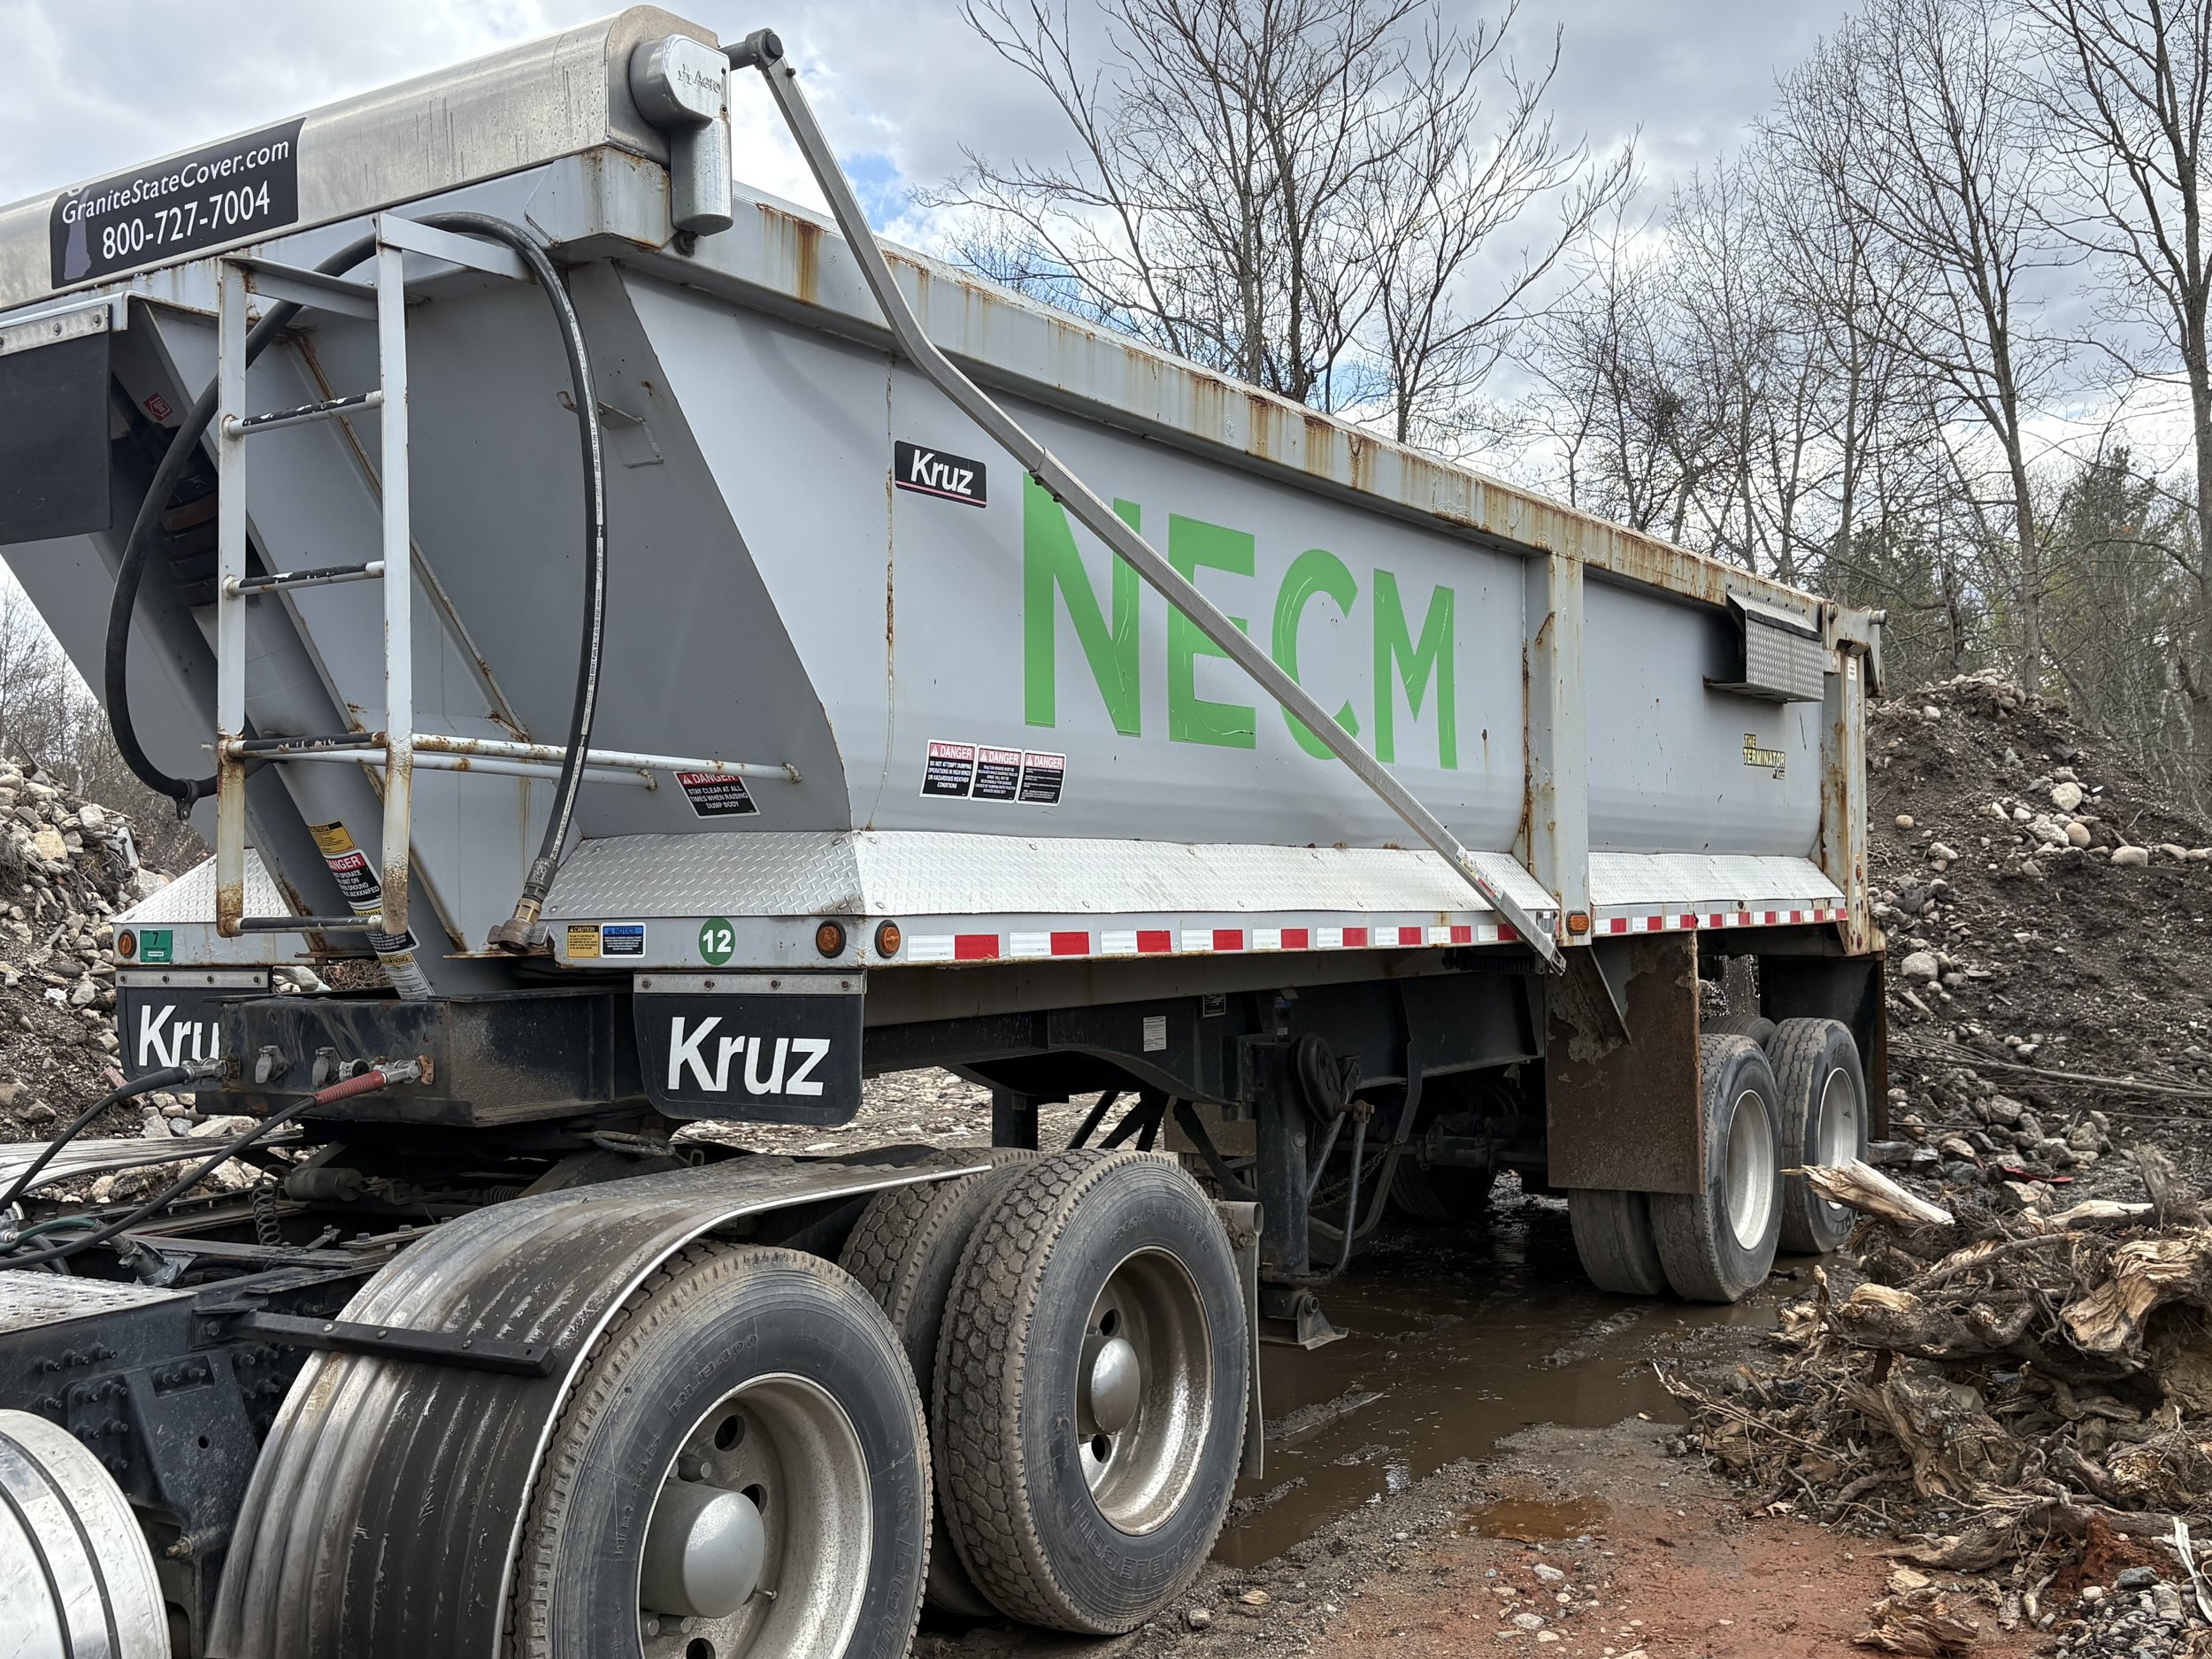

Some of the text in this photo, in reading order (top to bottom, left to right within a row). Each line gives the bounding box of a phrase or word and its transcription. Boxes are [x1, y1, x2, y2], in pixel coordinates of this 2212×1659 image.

[63, 141, 288, 223] GraniteStateCover.com
[103, 180, 270, 259] 800-727-7004
[910, 449, 973, 495] Kruz
[1023, 472, 1457, 770] NECM
[941, 746, 972, 760] DANGER
[989, 752, 1018, 764] DANGER
[1743, 747, 1785, 768] TERMINATOR
[1744, 733, 1755, 748] THE
[1035, 756, 1062, 768] DANGER
[153, 933, 158, 945] 7
[703, 929, 732, 953] 12
[139, 1005, 219, 1068] Kru
[668, 1017, 830, 1096] Kruz
[1071, 1497, 1119, 1571] COIN
